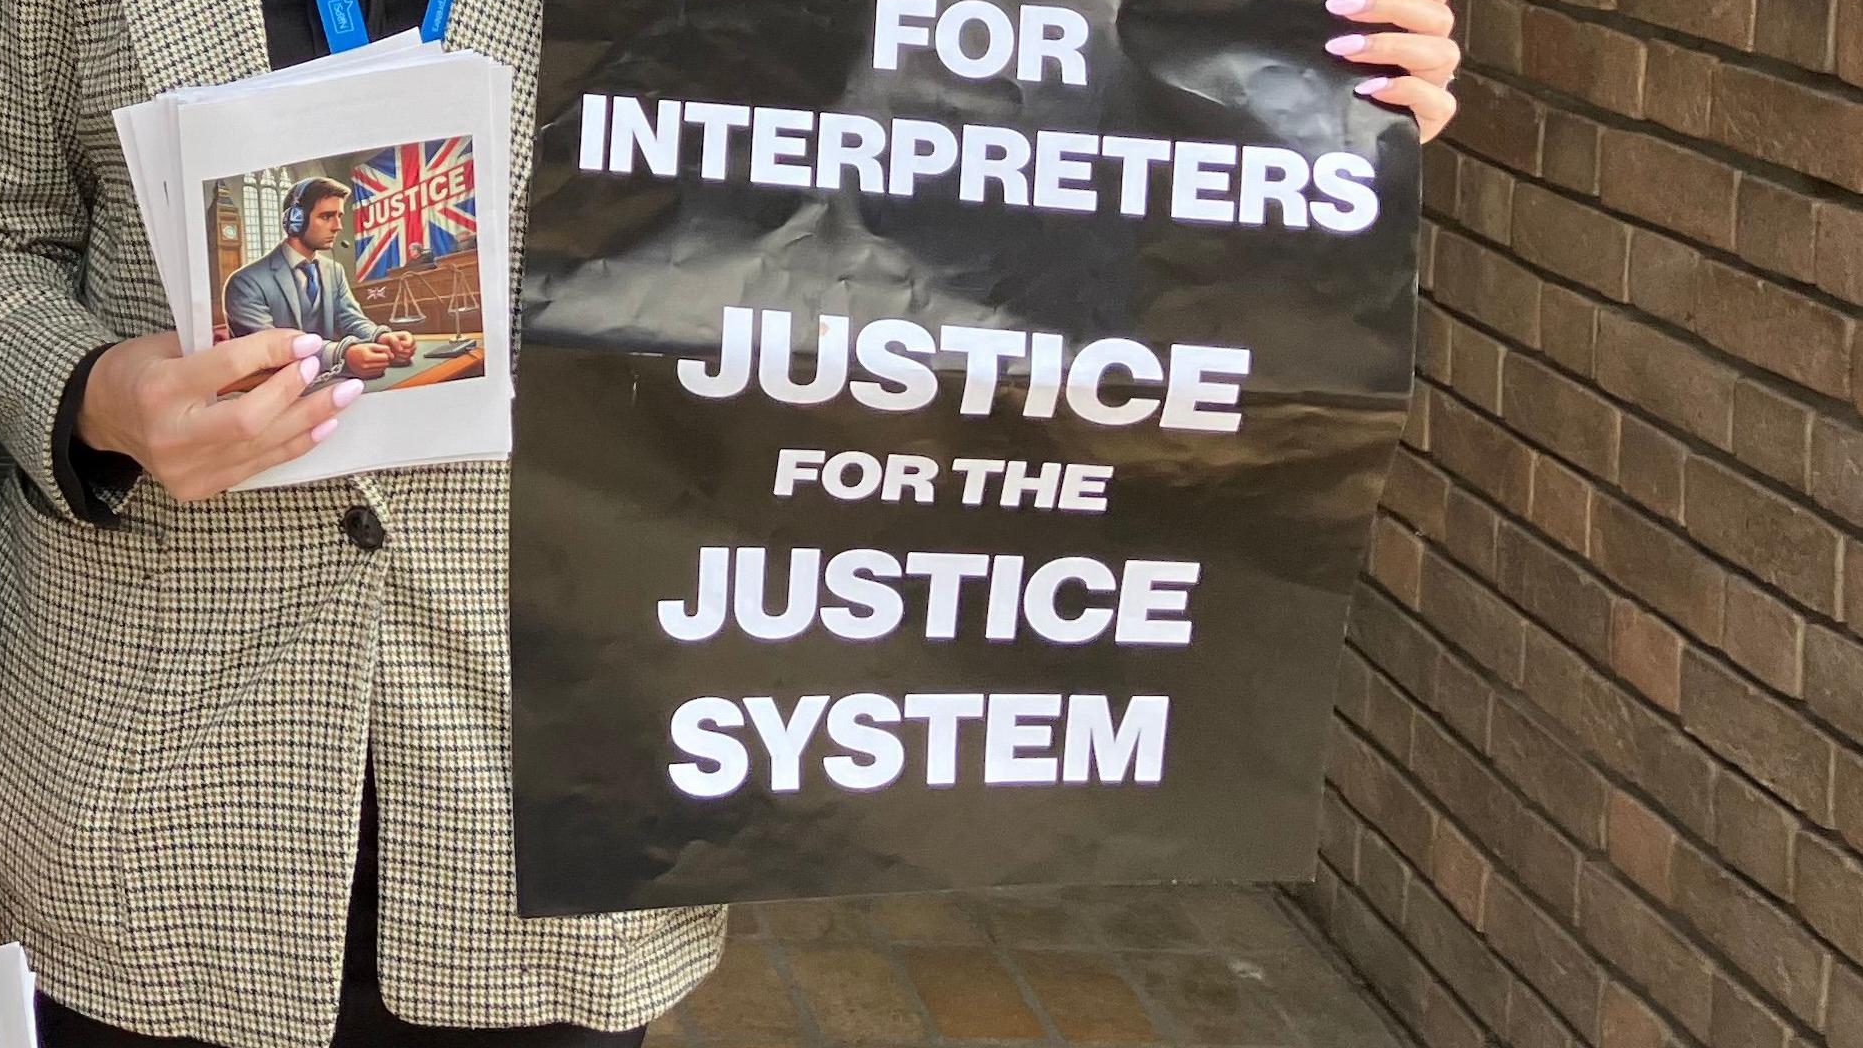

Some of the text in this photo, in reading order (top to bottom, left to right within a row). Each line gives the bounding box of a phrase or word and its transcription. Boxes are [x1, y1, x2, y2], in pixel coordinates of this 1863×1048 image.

[363, 166, 465, 229] JUSTICE
[578, 94, 1380, 232] INTERPRETERS
[677, 305, 1251, 432] JUSTICE
[773, 449, 1114, 511] FOR THE
[657, 546, 1202, 645] JUSTICE
[668, 692, 1170, 797] SYSTEM
